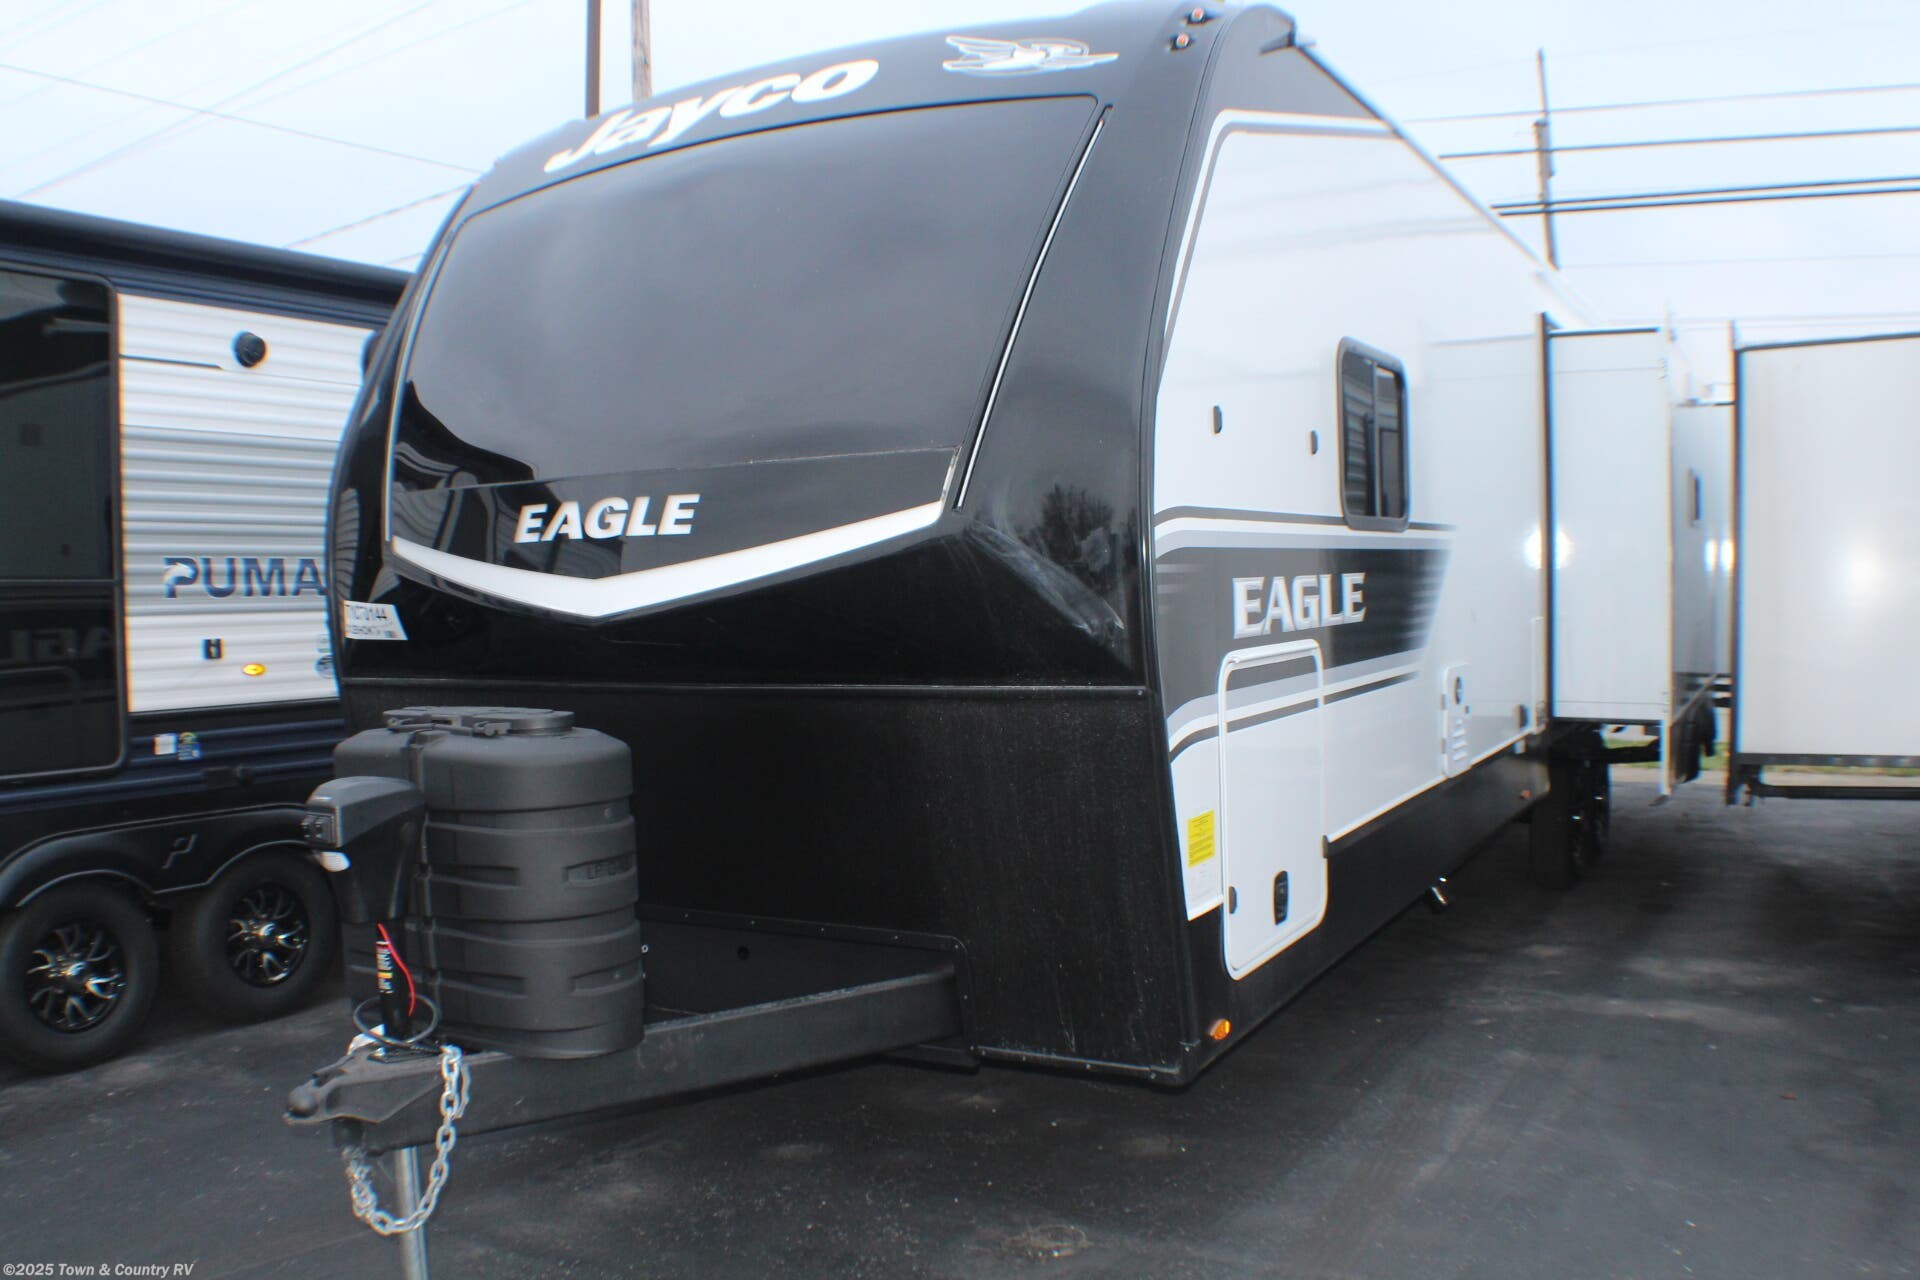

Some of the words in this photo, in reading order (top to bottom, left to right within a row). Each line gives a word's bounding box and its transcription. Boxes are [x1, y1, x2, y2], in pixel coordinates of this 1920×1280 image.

[544, 59, 879, 173] Jayco
[513, 493, 701, 544] EAGLE
[162, 557, 327, 599] PUMA
[1232, 572, 1366, 640] EAGLE
